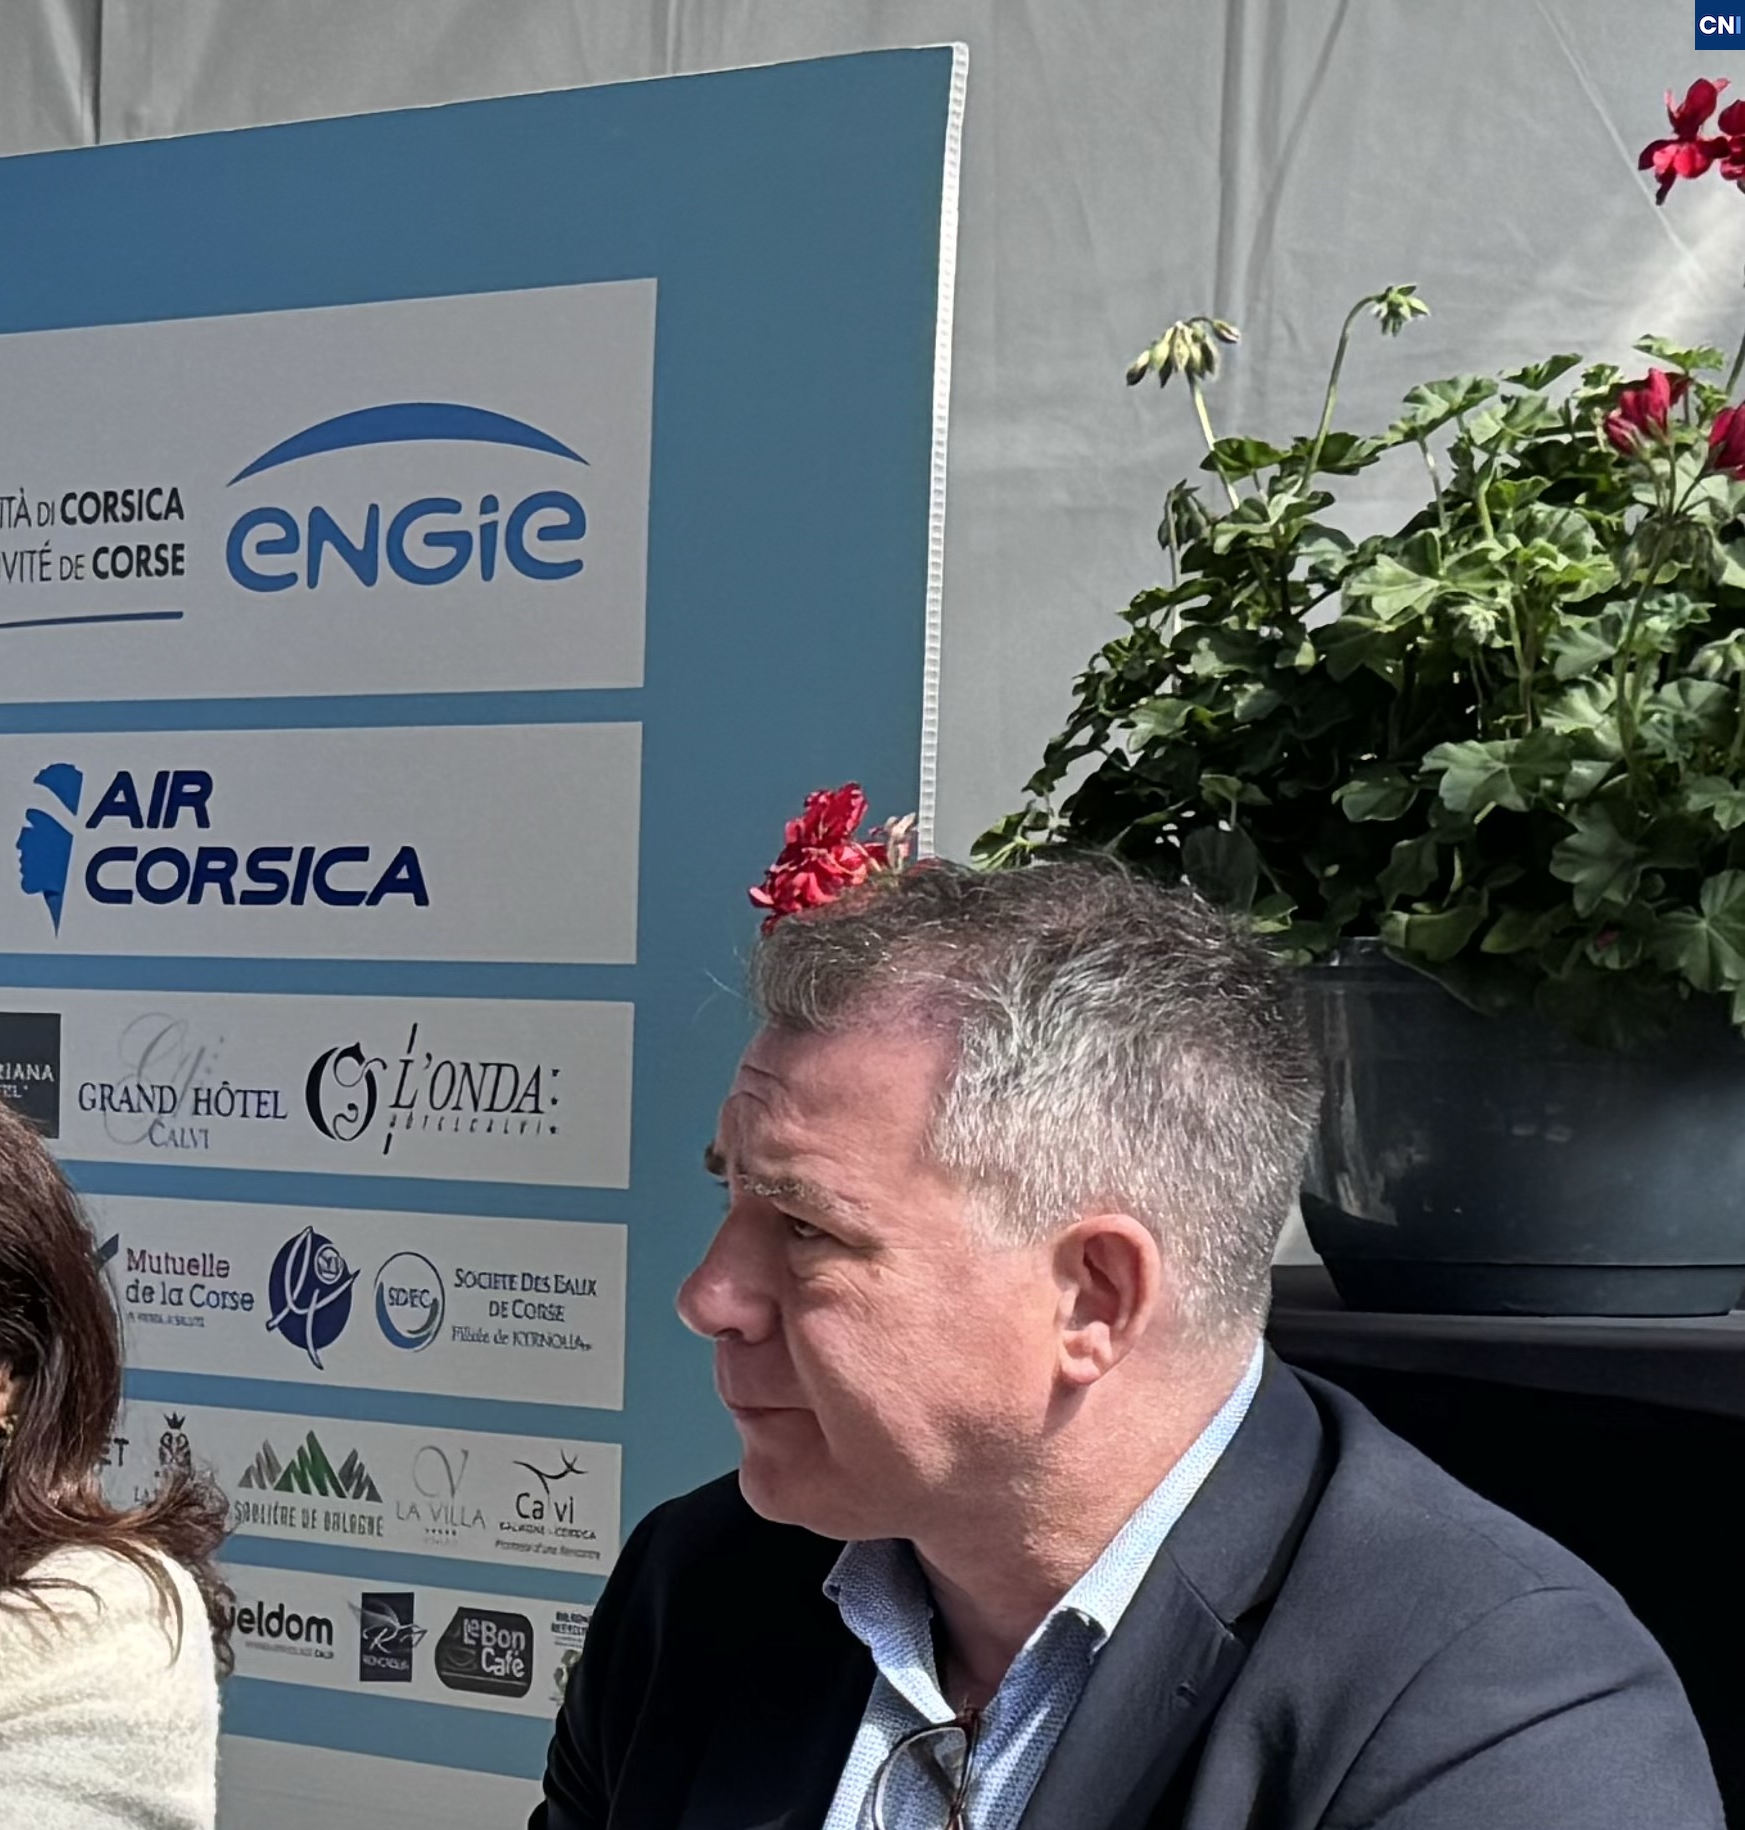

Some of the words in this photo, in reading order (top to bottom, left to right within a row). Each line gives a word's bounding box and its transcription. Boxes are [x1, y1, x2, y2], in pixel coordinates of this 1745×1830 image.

[36, 499, 57, 529] DI
[60, 485, 186, 526] CORSICA
[60, 552, 89, 583] DE
[93, 542, 186, 580] CORSE
[85, 769, 214, 829] AIR
[85, 846, 431, 907] CORSICA
[78, 1081, 178, 1119] GRAND
[193, 1079, 289, 1120] HÔTEL
[126, 1247, 231, 1279] Mutuelle
[126, 1278, 156, 1304] de
[160, 1281, 185, 1306] la
[189, 1283, 256, 1312] Corse
[388, 1286, 434, 1309] SDEC
[488, 1299, 510, 1319] DE
[395, 1500, 421, 1522] LA
[429, 1501, 487, 1530] VILLA
[230, 1602, 334, 1647] eldom
[480, 1647, 526, 1679] Café
